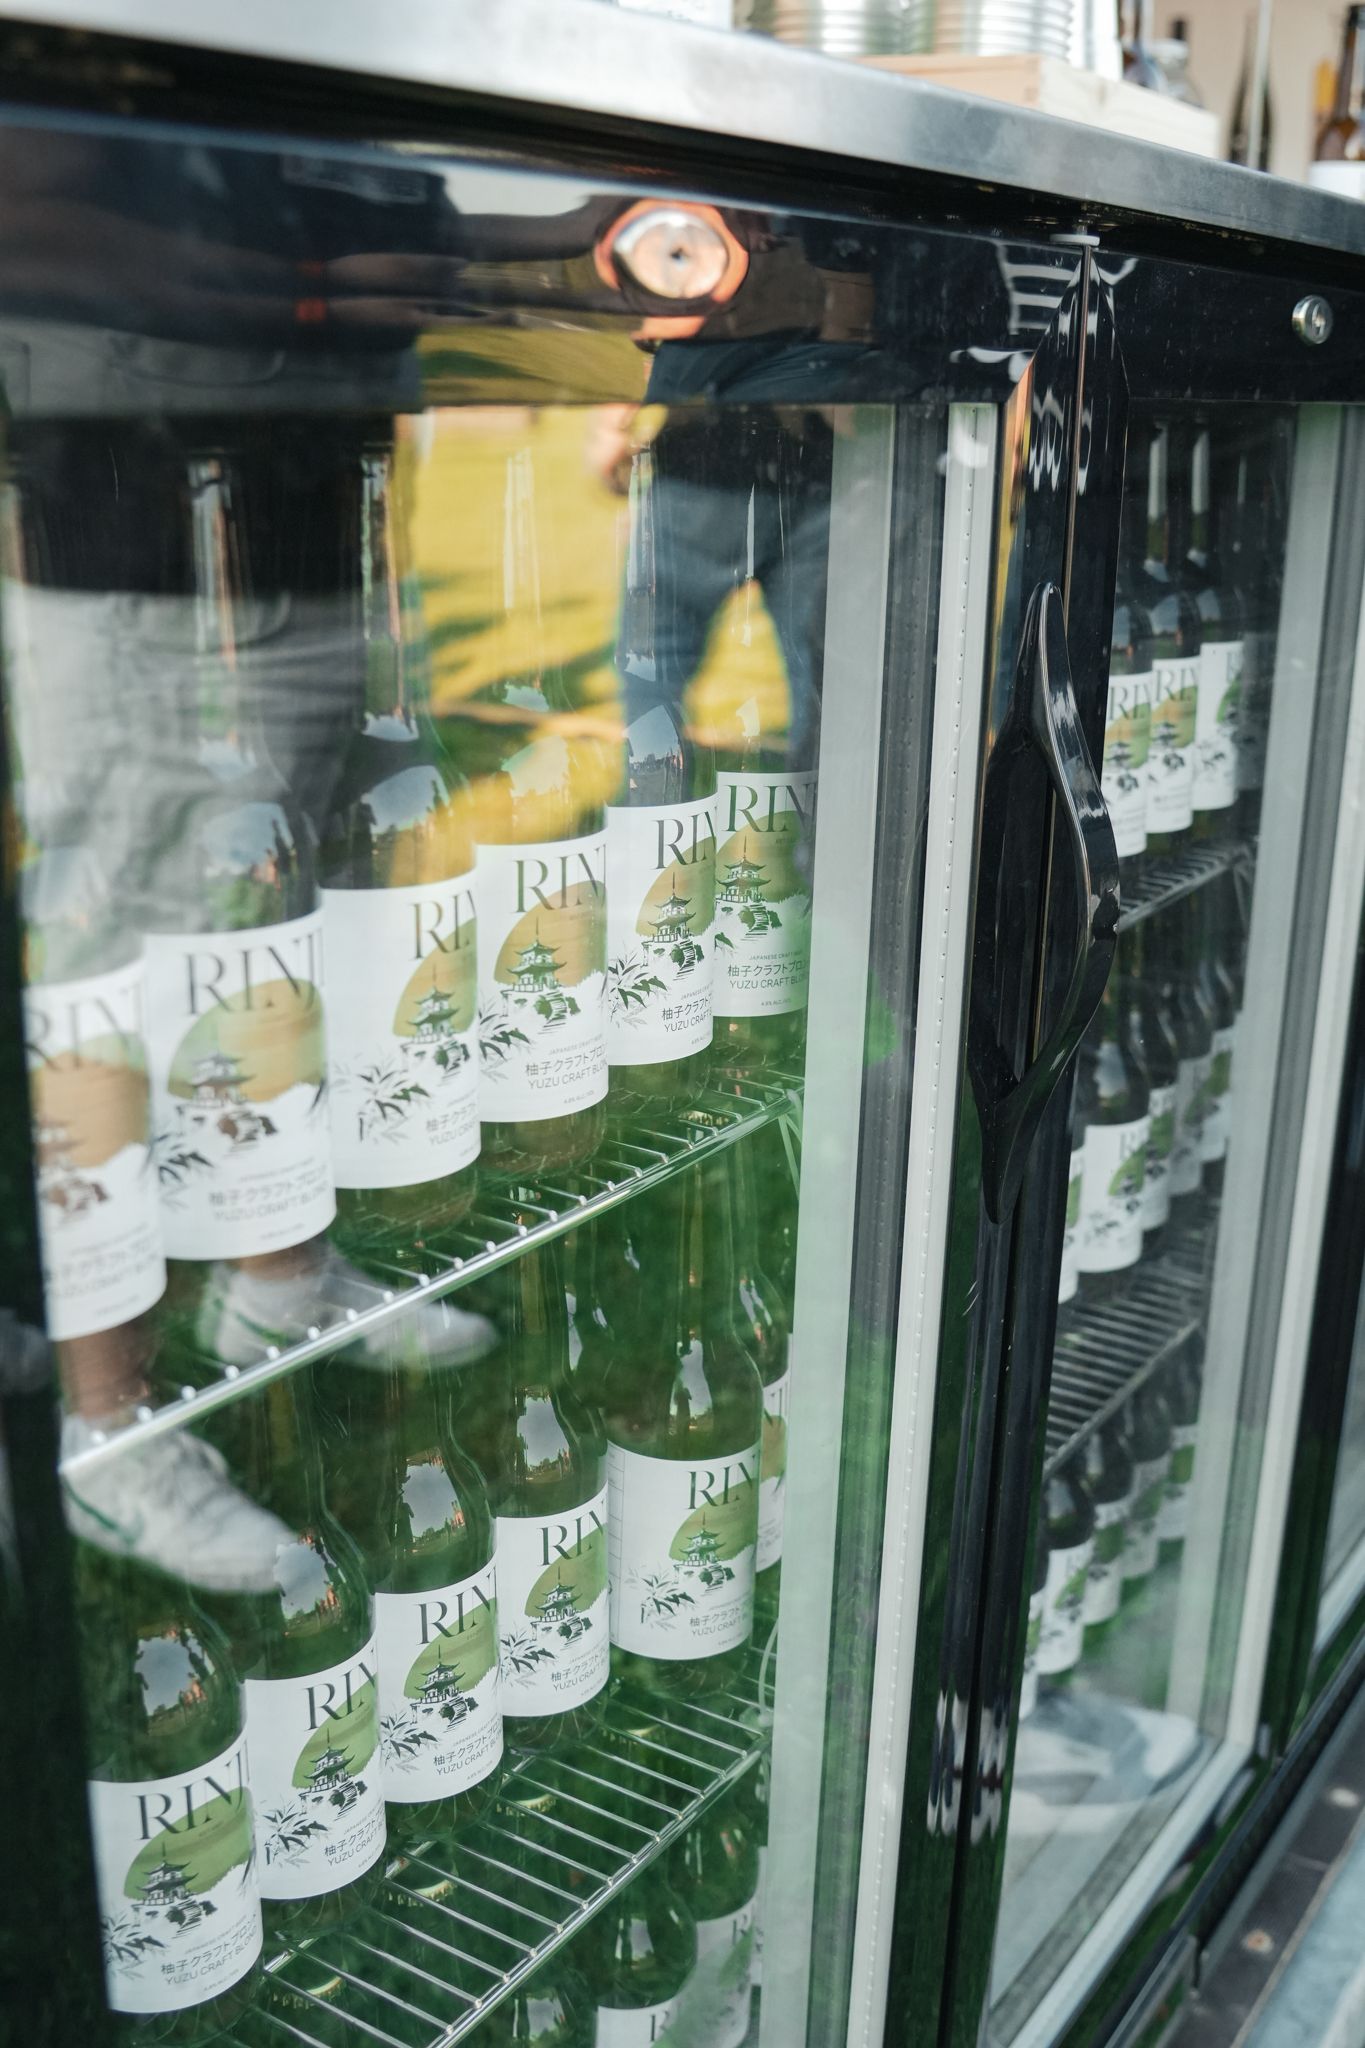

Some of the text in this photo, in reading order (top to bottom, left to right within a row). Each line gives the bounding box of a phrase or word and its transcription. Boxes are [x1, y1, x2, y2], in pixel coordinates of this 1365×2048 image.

[729, 979, 759, 990] YUZU
[760, 975, 790, 989] CRAFT
[664, 1019, 690, 1033] YUZU
[527, 1076, 561, 1090] YUZU
[561, 1066, 592, 1086] CRAFT
[692, 1625, 716, 1637] YUZU
[553, 1677, 578, 1692] YUZU
[436, 1760, 464, 1775] YUZU
[464, 1743, 489, 1766] CRAFT
[327, 1848, 355, 1867] YUZU
[165, 1970, 199, 1985] YUZU
[200, 1950, 234, 1977] CRAFT
